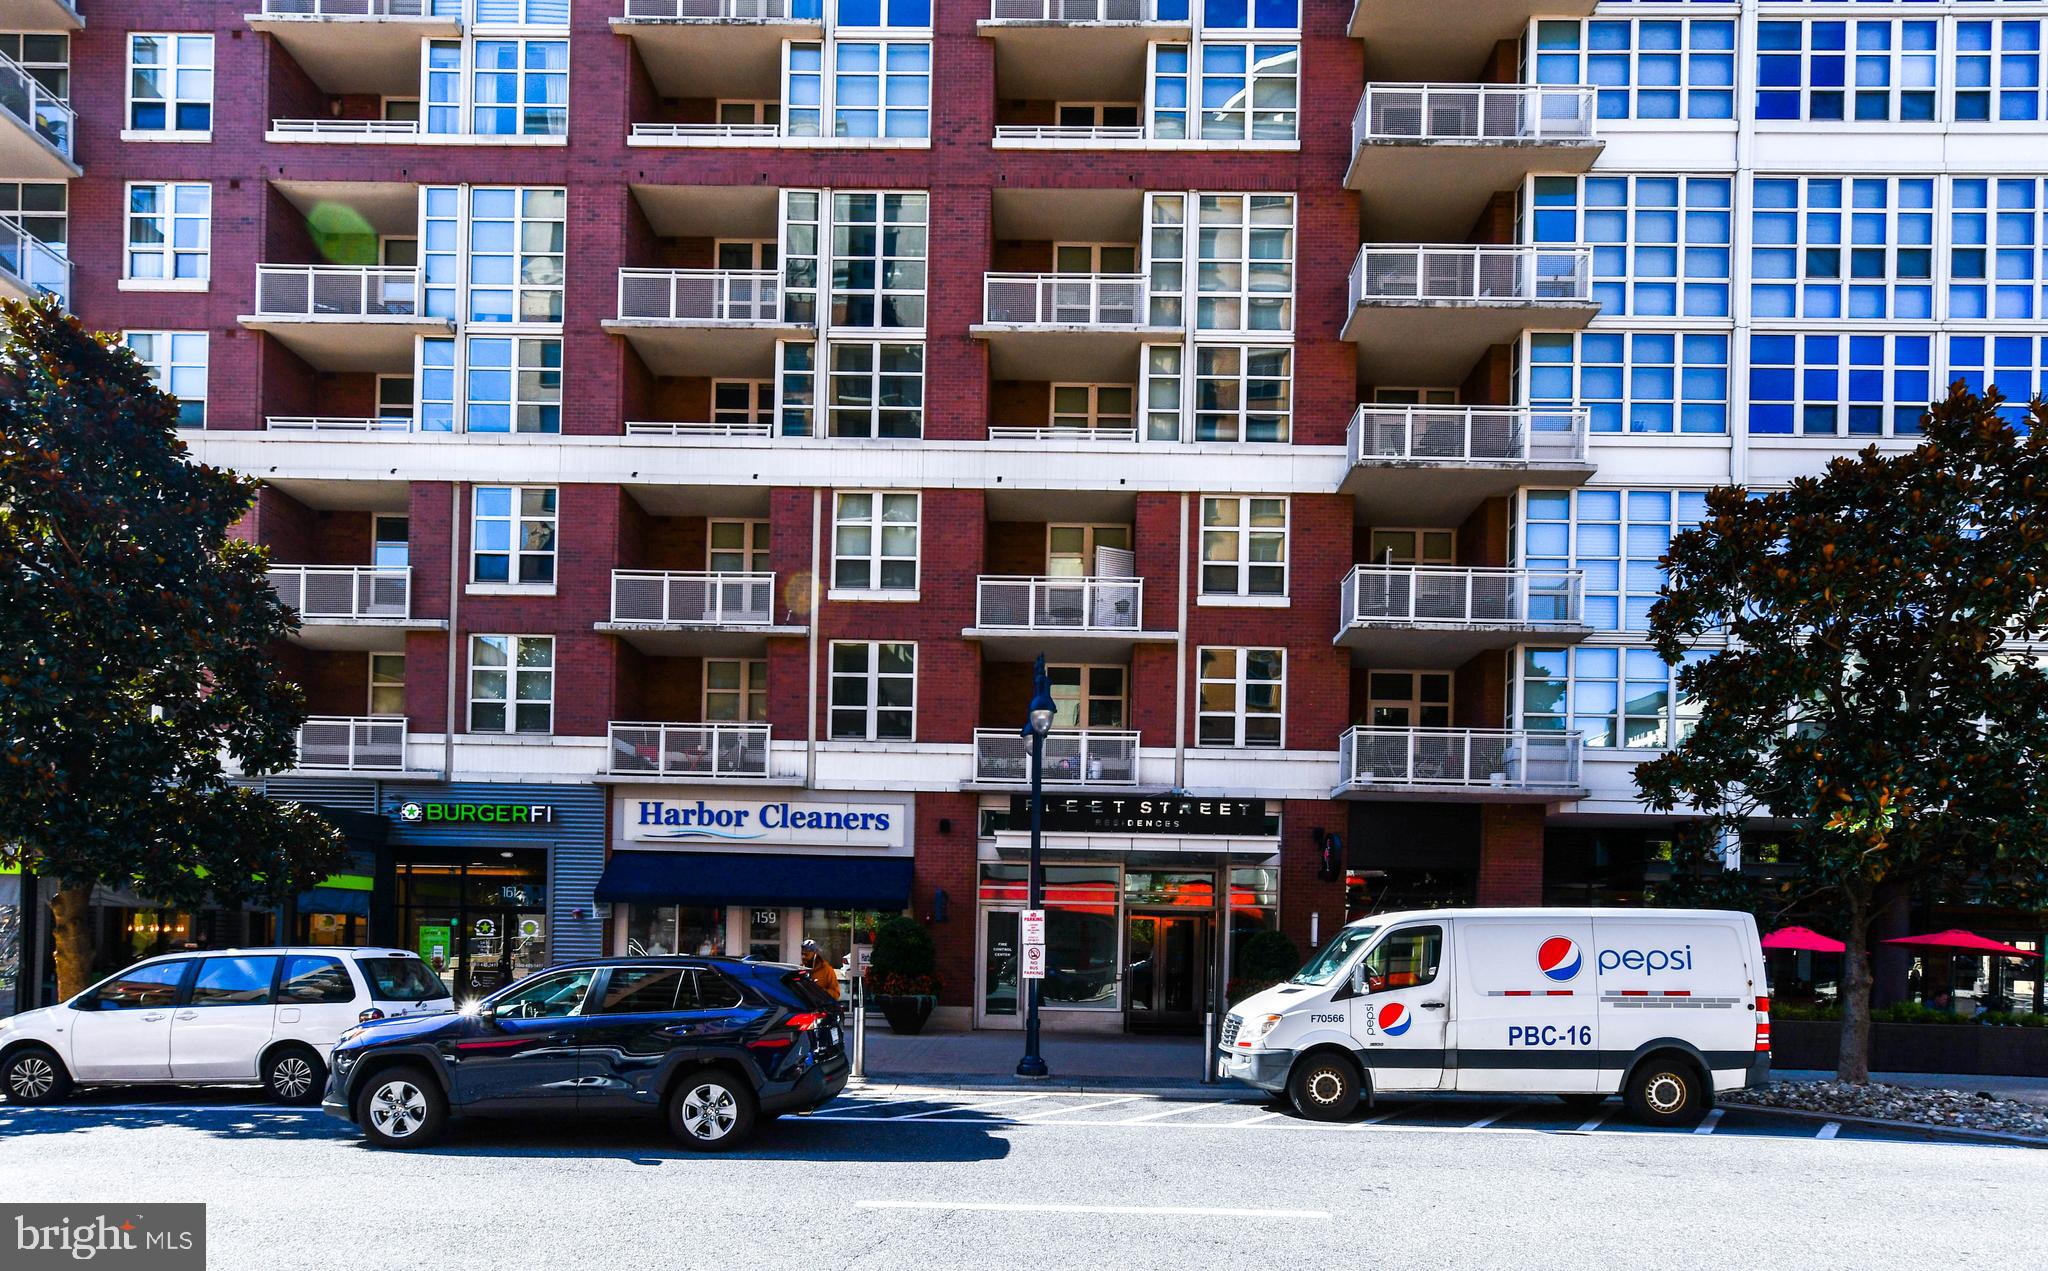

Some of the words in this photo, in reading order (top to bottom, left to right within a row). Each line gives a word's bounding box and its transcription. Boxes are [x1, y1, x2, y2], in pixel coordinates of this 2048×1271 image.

[427, 803, 551, 823] BURGERFI
[638, 801, 750, 828] Harbor
[759, 803, 890, 831] Cleaners
[1140, 801, 1251, 816] STREET
[1094, 818, 1180, 828] RESIDENCES
[502, 886, 517, 898] 161
[755, 911, 776, 924] 159
[1598, 944, 1693, 976] pepsi
[1310, 1014, 1345, 1023] F70566
[1365, 1003, 1376, 1036] pepsi
[1508, 1025, 1592, 1046] PBC-16
